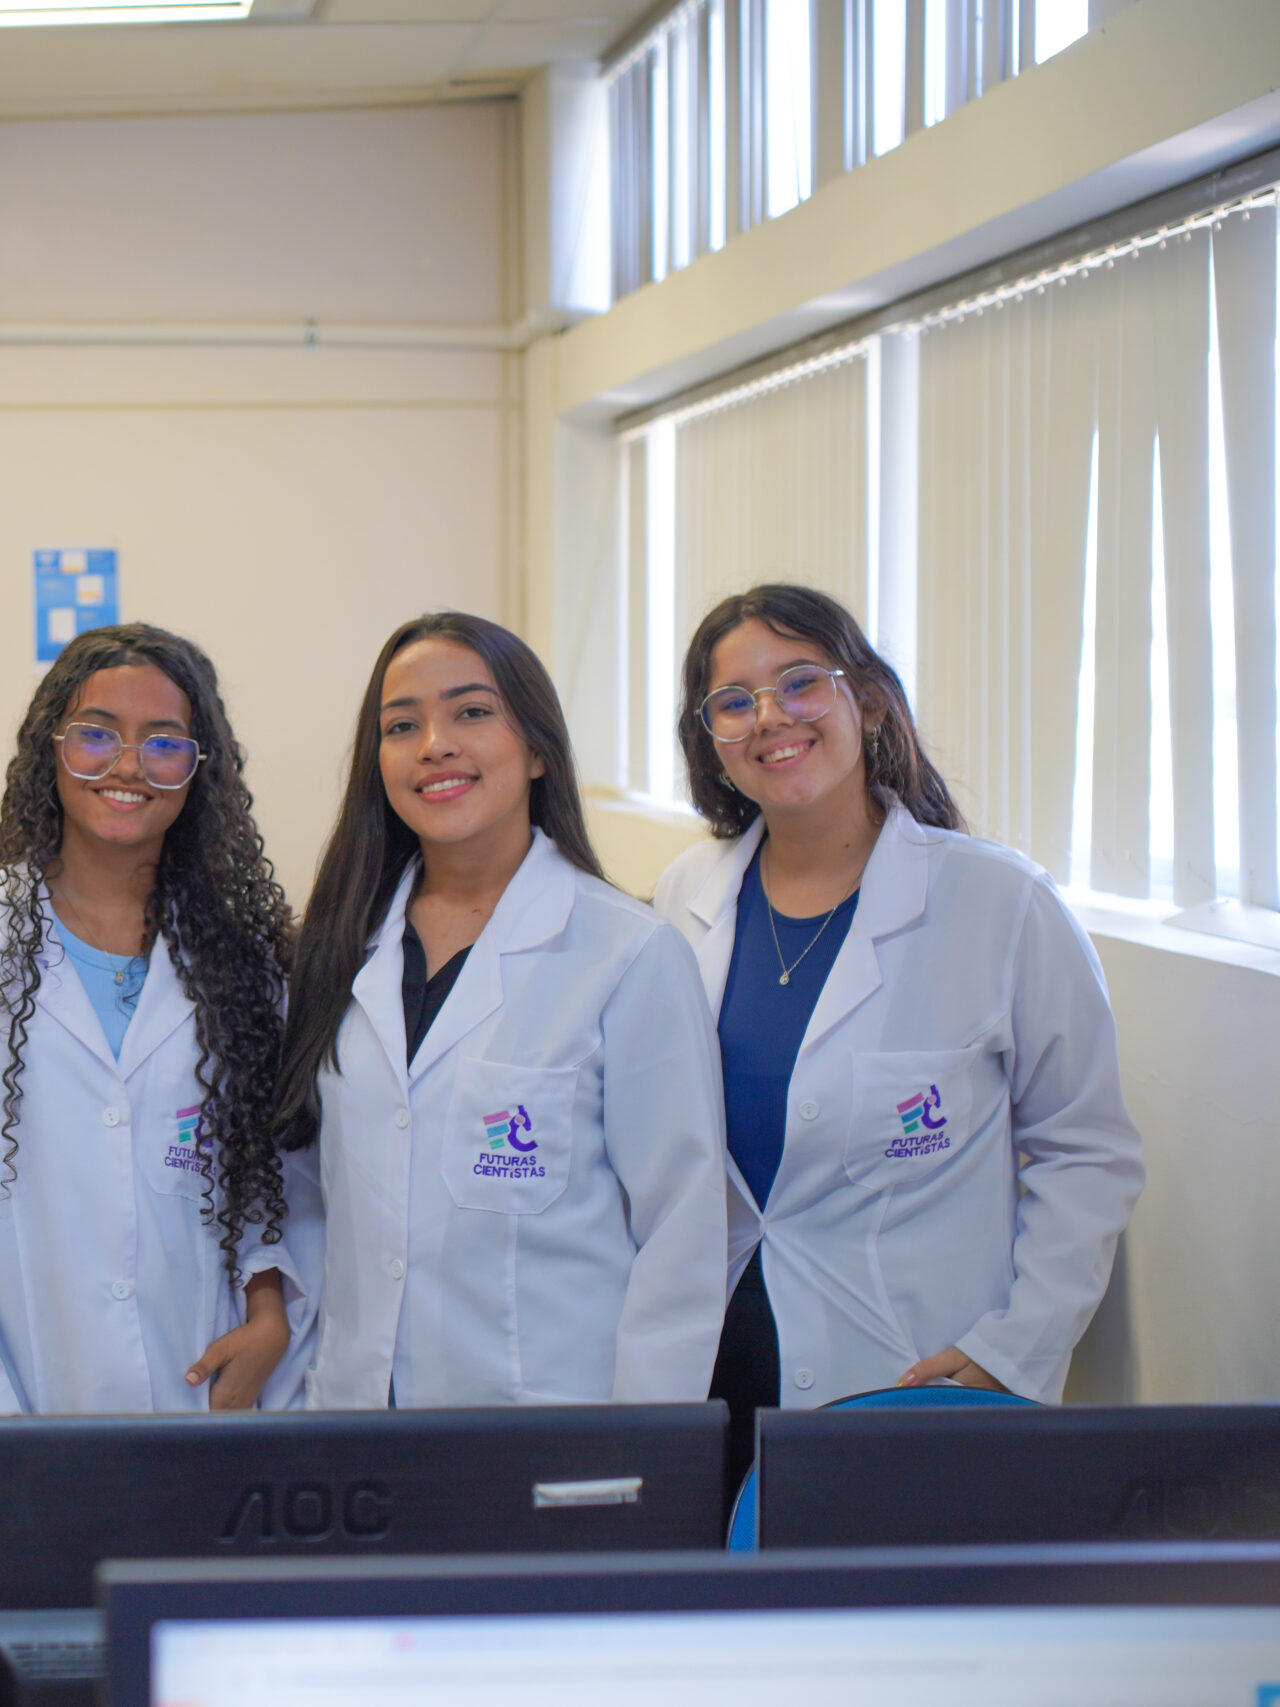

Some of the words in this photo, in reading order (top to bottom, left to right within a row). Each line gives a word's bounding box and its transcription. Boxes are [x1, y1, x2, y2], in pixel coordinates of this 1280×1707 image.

[891, 1130, 945, 1149] FUTURAS
[479, 1152, 537, 1167] FUTURAS
[215, 1478, 393, 1544] AOC
